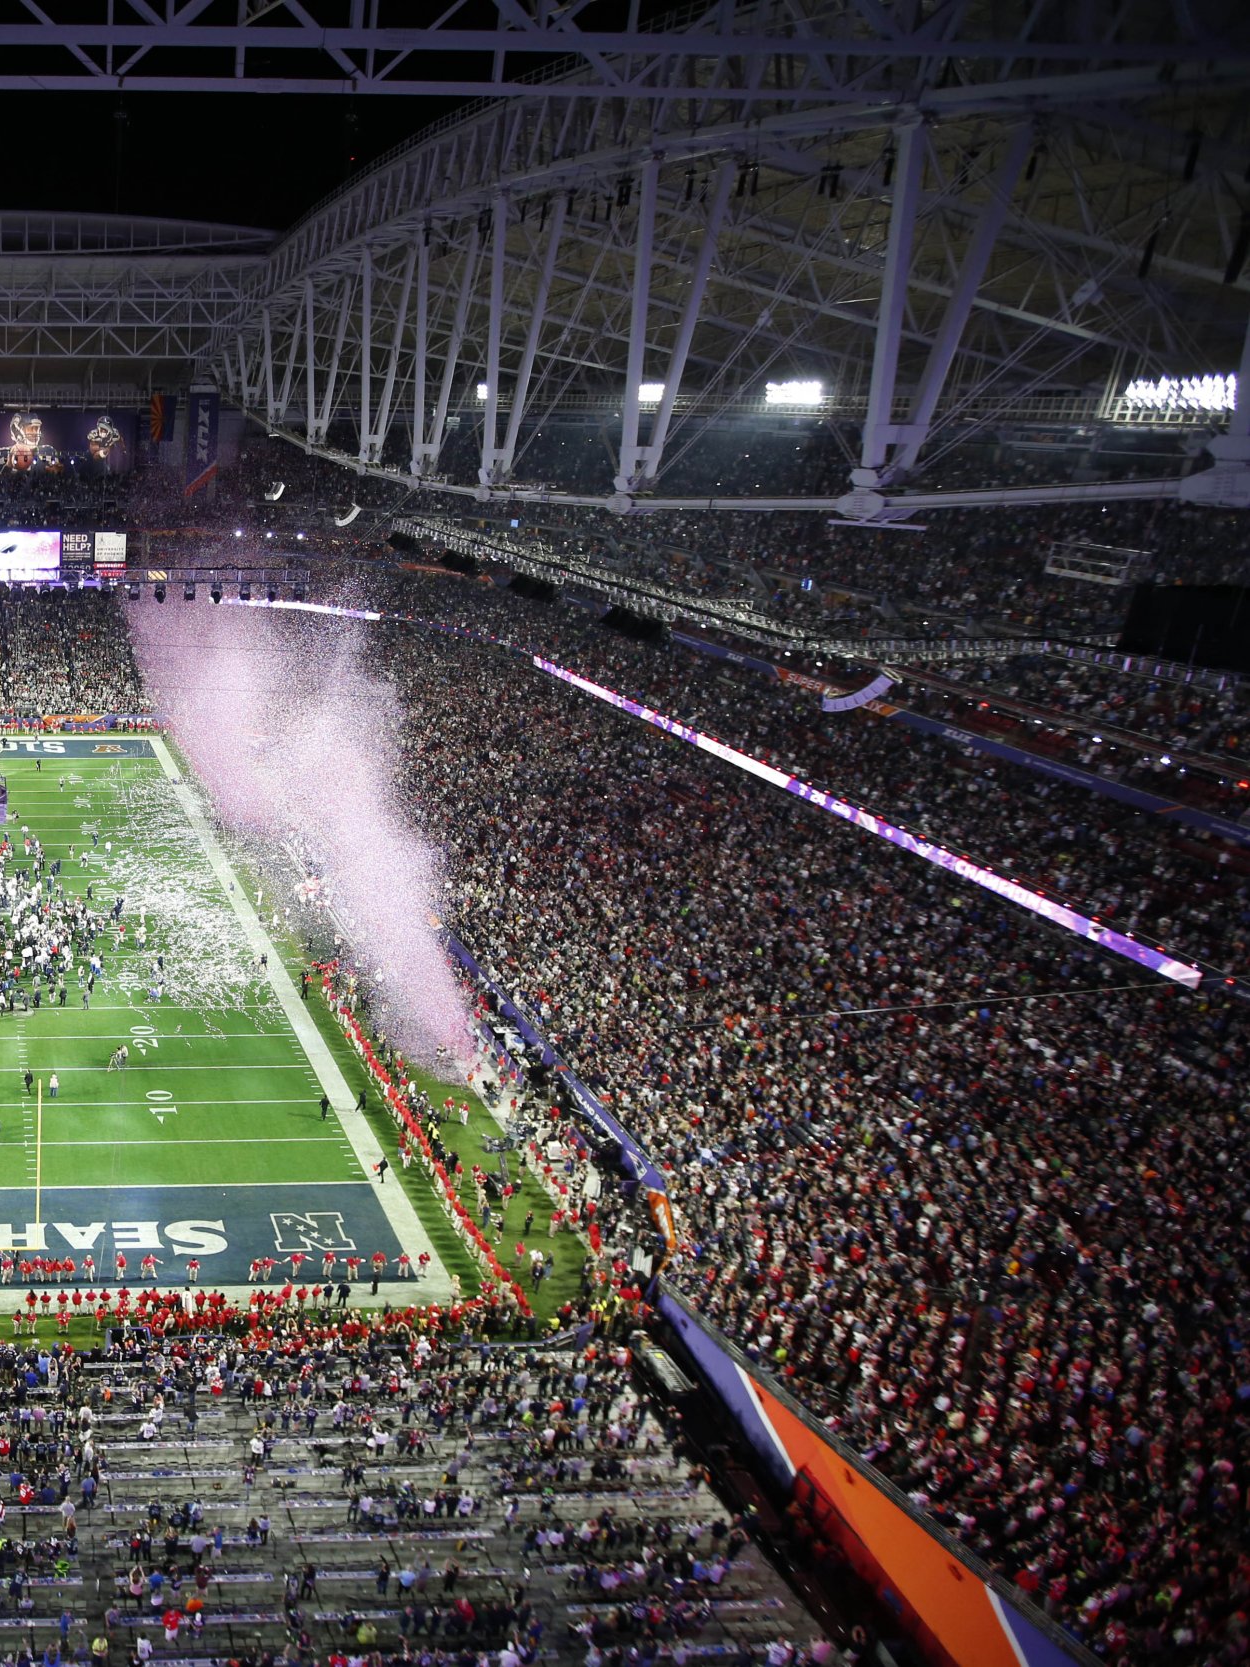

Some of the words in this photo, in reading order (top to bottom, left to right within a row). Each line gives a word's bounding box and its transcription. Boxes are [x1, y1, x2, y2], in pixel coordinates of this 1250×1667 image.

[197, 405, 210, 463] XLIX
[63, 534, 88, 542] NEED
[63, 543, 92, 551] HELP?
[944, 728, 974, 745] XLIX
[954, 860, 1054, 916] CHAMPIONS
[130, 1025, 159, 1048] 20
[145, 1089, 178, 1115] 10
